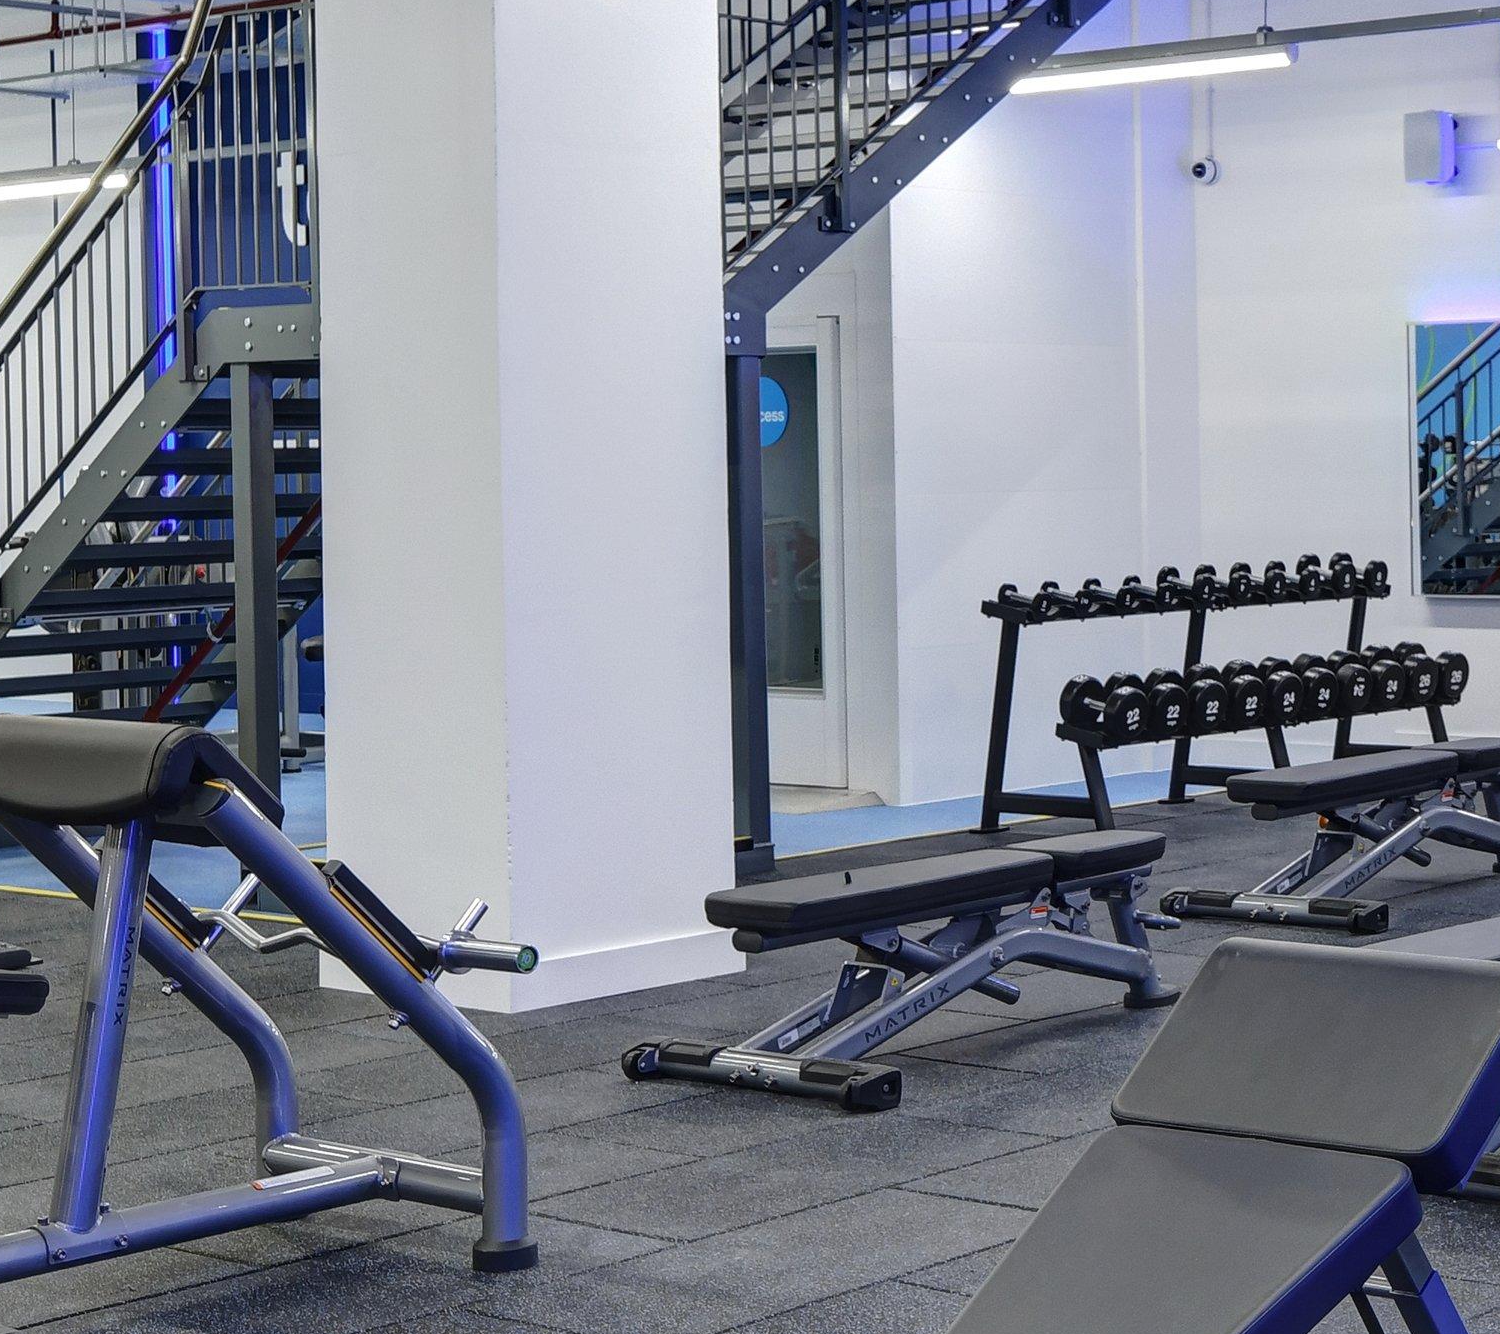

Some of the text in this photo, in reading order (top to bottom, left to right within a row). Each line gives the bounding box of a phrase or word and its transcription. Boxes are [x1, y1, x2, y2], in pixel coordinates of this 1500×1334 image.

[1450, 670, 1463, 684] 26
[1317, 687, 1331, 701] 24
[1166, 704, 1180, 719] 22
[1344, 846, 1398, 889] MATRIX
[112, 926, 137, 1026] MATRIX
[864, 982, 951, 1044] MATRIX
